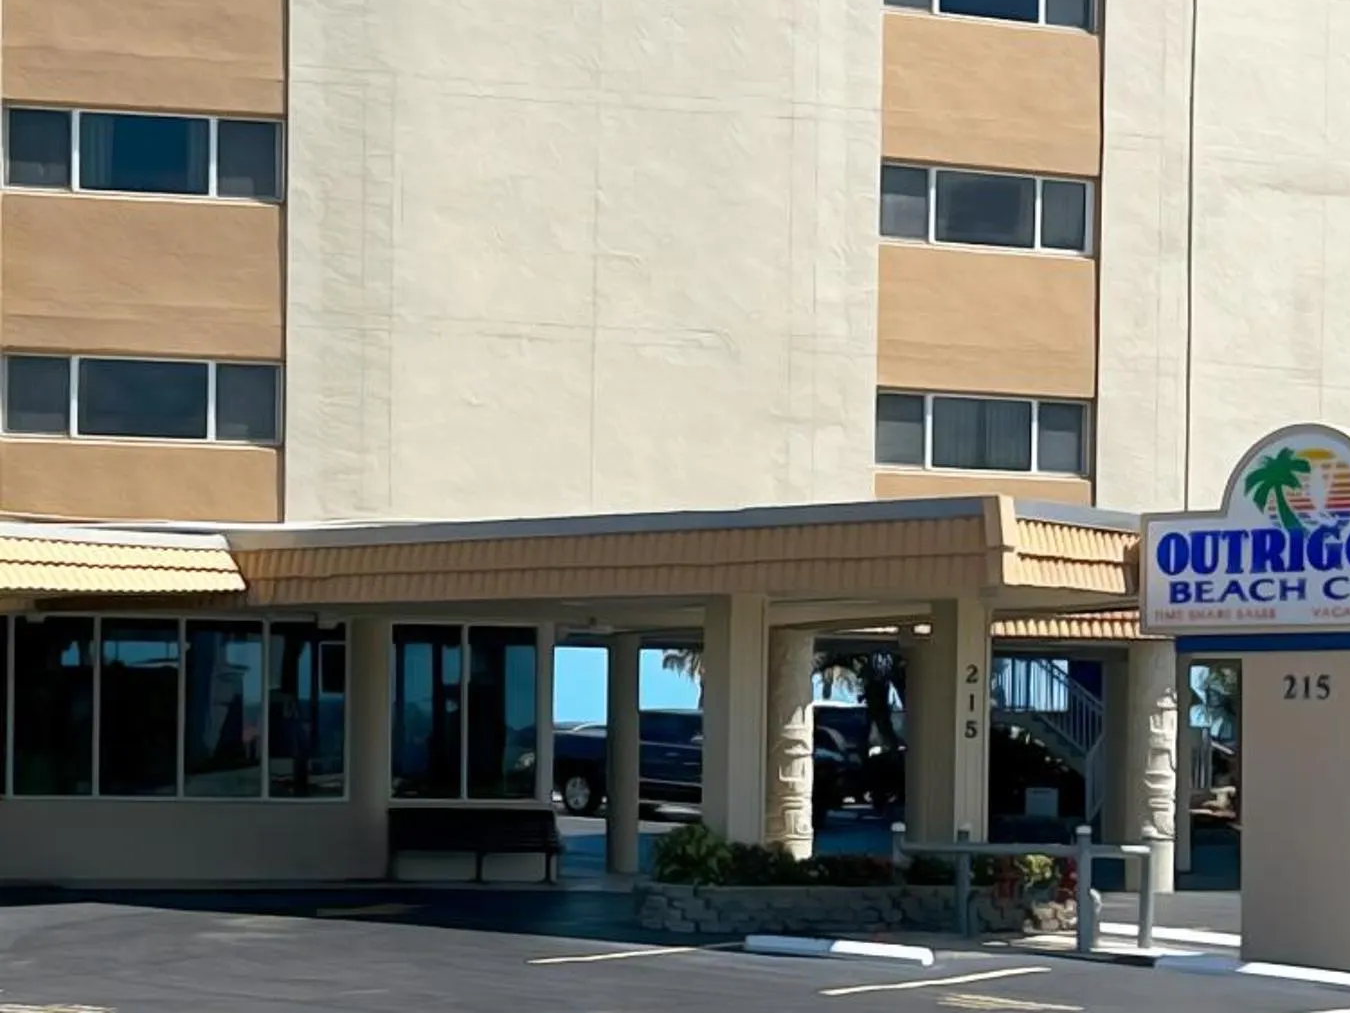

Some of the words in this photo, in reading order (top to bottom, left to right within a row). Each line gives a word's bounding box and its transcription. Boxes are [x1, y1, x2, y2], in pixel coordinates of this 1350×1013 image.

[1169, 577, 1307, 604] BEACH
[1283, 674, 1331, 700] 215
[964, 663, 979, 739] 215
